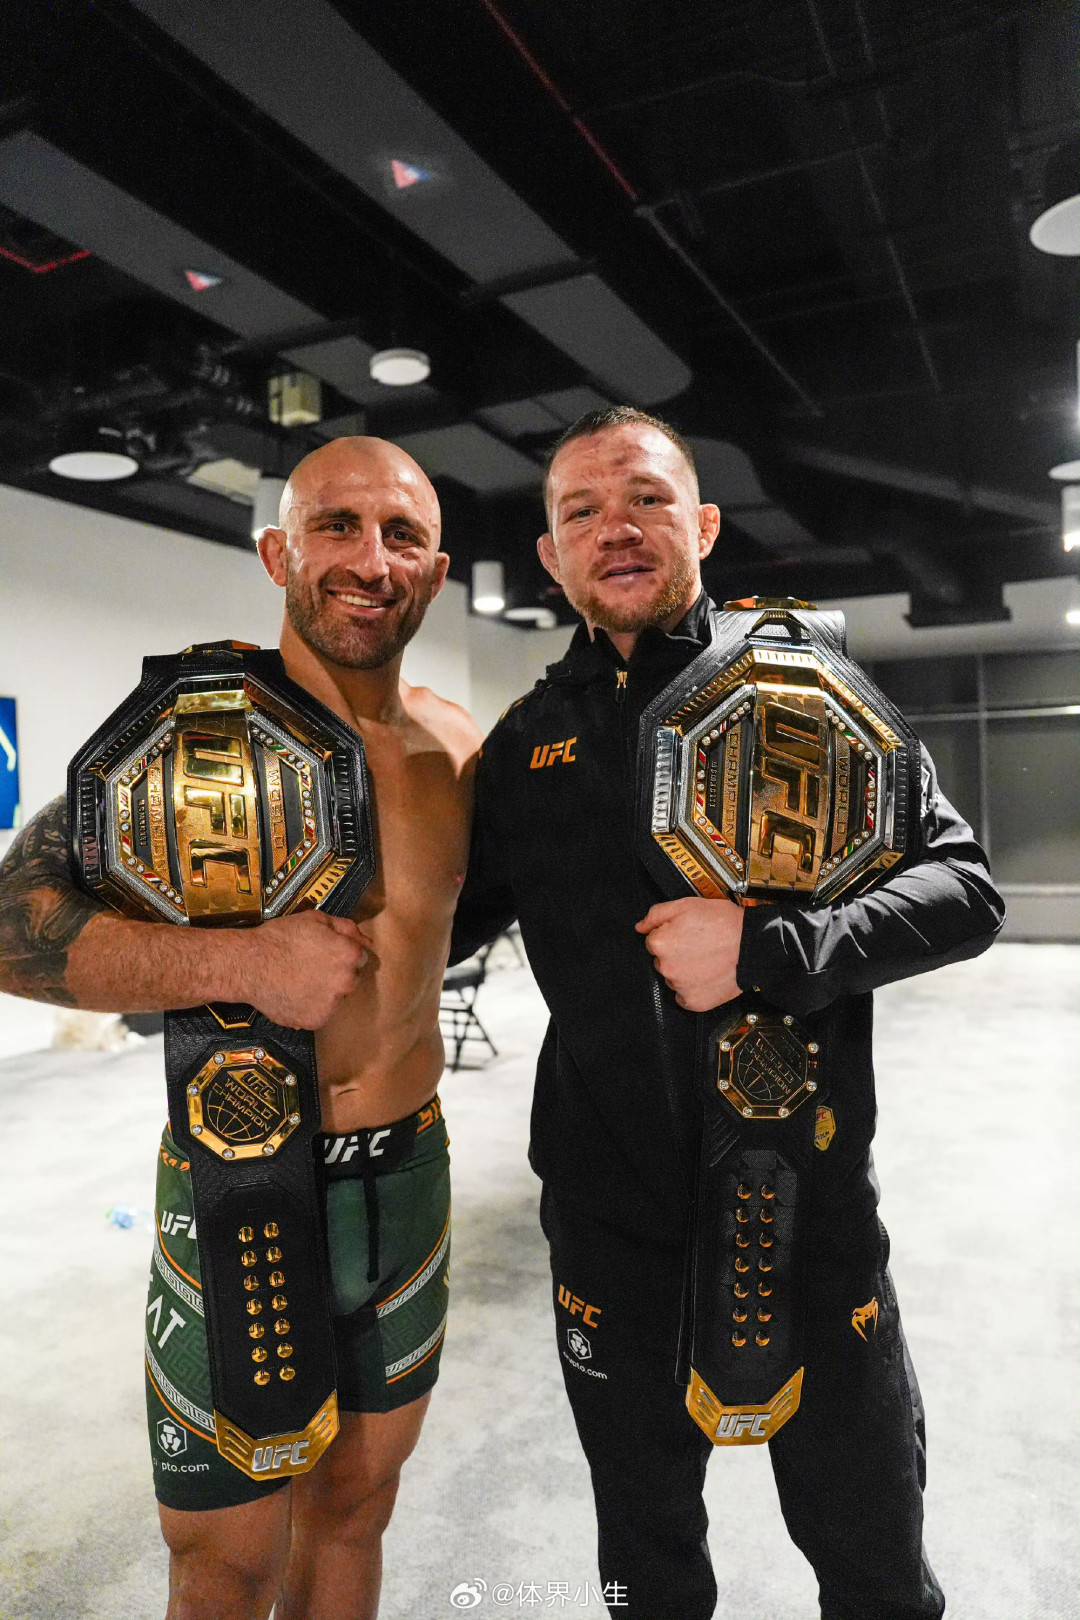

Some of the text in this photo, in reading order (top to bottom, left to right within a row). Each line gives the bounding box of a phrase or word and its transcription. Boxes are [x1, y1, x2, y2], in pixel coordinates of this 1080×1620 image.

[530, 737, 577, 769] UFC
[268, 769, 285, 848] WORLD
[724, 733, 738, 837] CHAMPION
[759, 702, 819, 874] UFC
[837, 756, 849, 835] WORLD
[148, 766, 166, 871] CHAMPION
[182, 730, 252, 895] UFC
[212, 1083, 271, 1132] CHAMPION
[225, 1078, 273, 1120] WORLD
[242, 1071, 276, 1100] UFC
[558, 1283, 602, 1329] UFC
[716, 1413, 771, 1437] UFC
[252, 1440, 310, 1472] UFC
